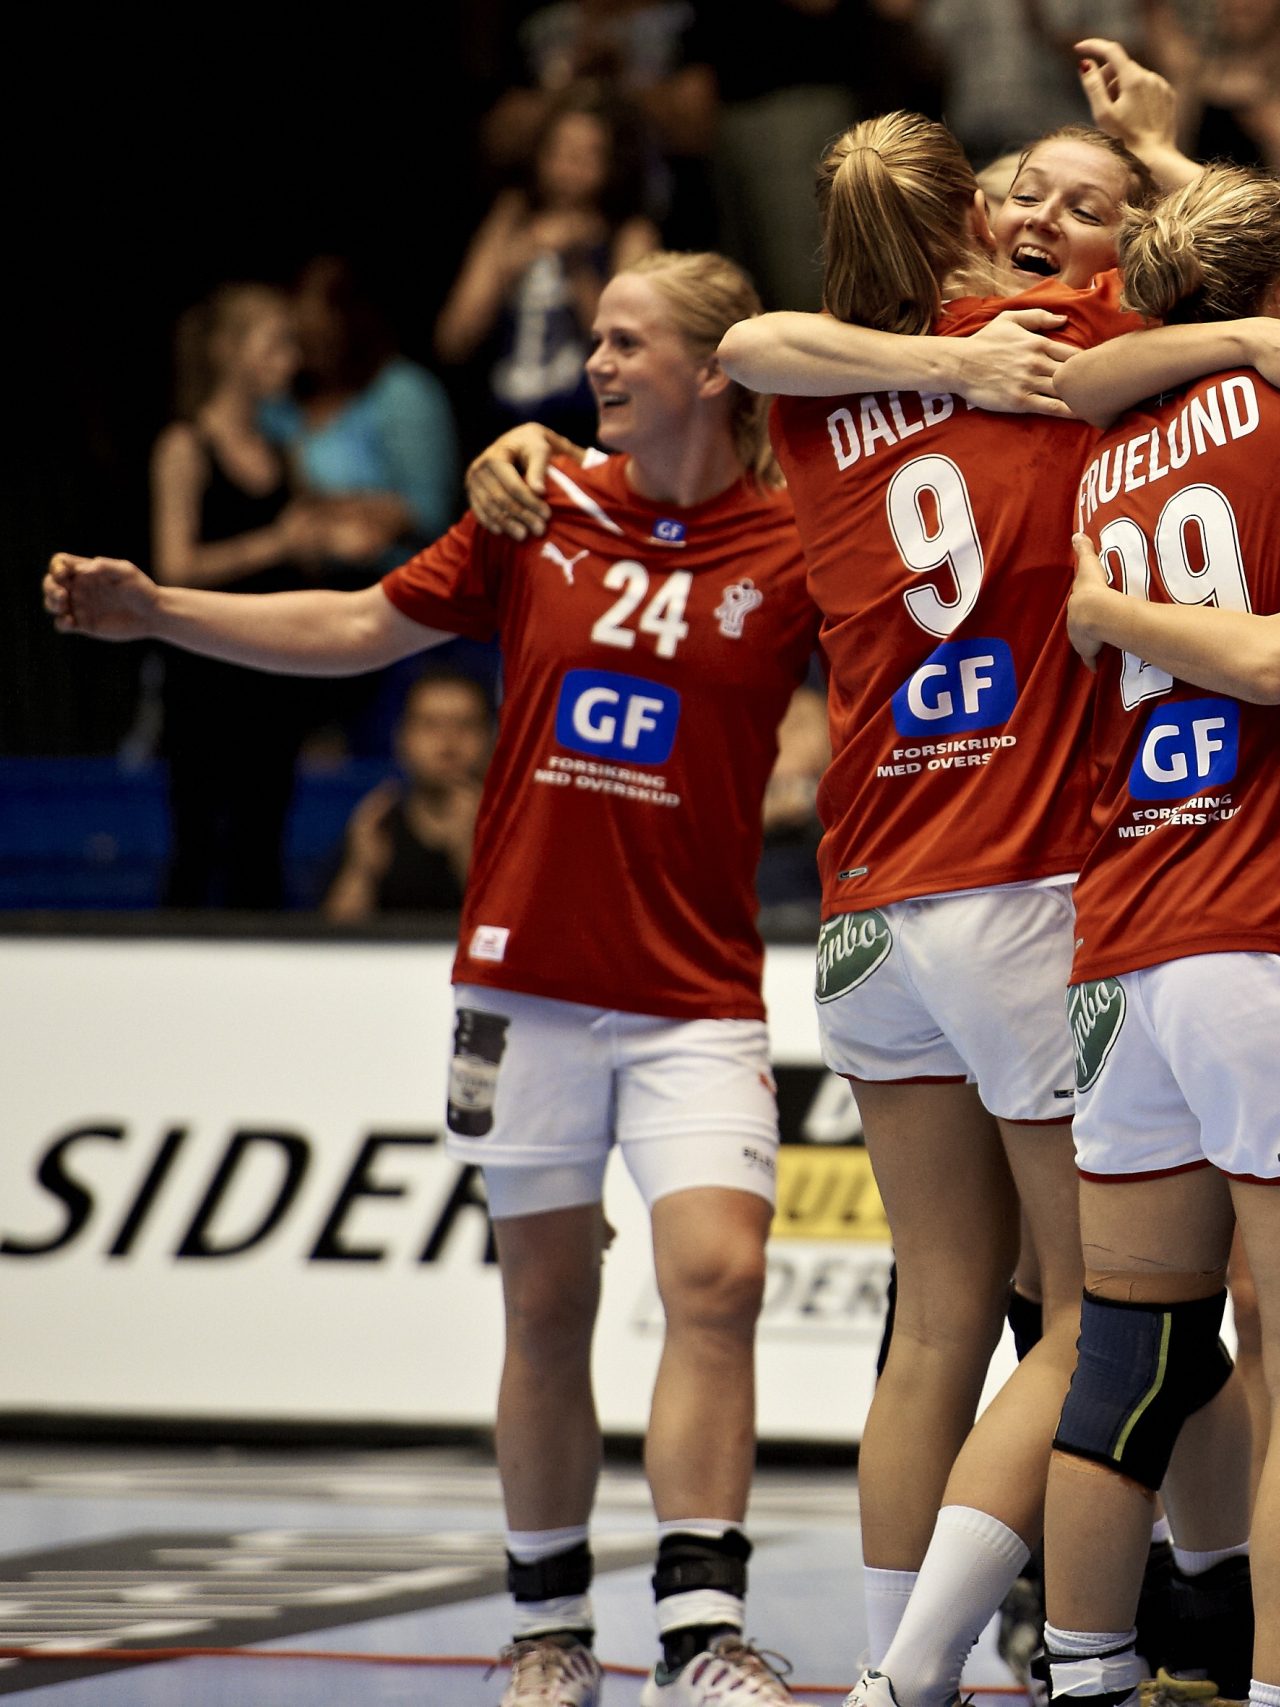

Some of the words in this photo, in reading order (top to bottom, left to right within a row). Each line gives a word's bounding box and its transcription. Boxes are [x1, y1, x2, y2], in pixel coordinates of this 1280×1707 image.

[827, 389, 976, 472] DALB
[1078, 375, 1260, 537] FRUELUND
[885, 453, 984, 638] 9
[591, 560, 693, 659] 24
[571, 686, 664, 749] GF
[907, 655, 995, 721] GF
[548, 755, 667, 791] FORSIKRING
[877, 763, 922, 778] MED
[1142, 717, 1226, 783] GF
[534, 768, 572, 787] MED
[575, 776, 681, 808] OVERSKUD
